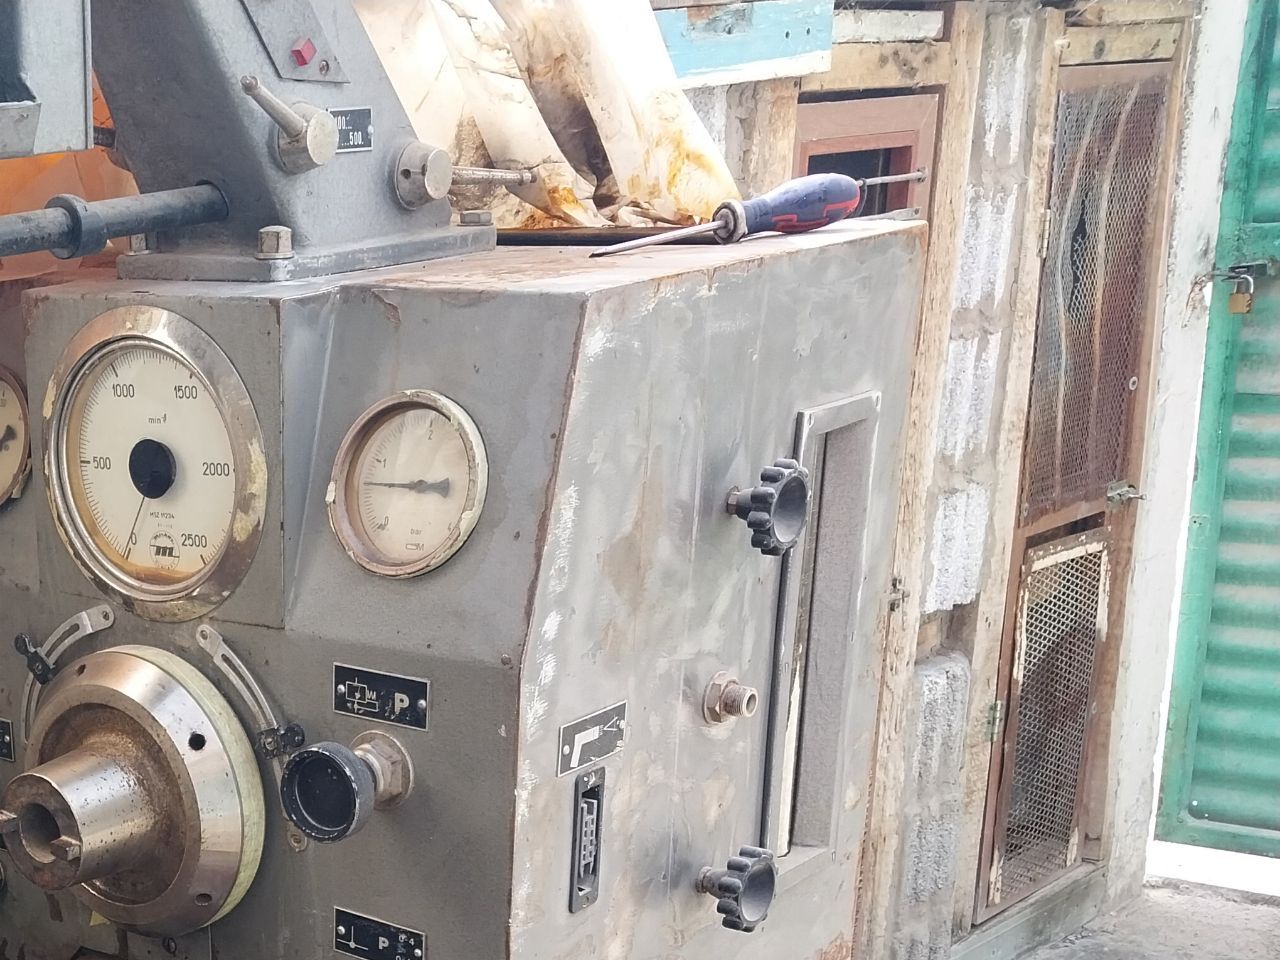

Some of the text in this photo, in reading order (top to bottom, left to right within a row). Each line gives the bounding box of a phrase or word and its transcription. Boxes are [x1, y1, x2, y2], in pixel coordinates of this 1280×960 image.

[112, 383, 135, 398] 1000
[174, 385, 198, 400] 1500
[427, 430, 434, 441] 2
[93, 456, 111, 470] 500
[202, 462, 230, 477] 2000
[181, 533, 208, 549] 2500
[394, 692, 410, 715] P
[378, 936, 390, 950] P
